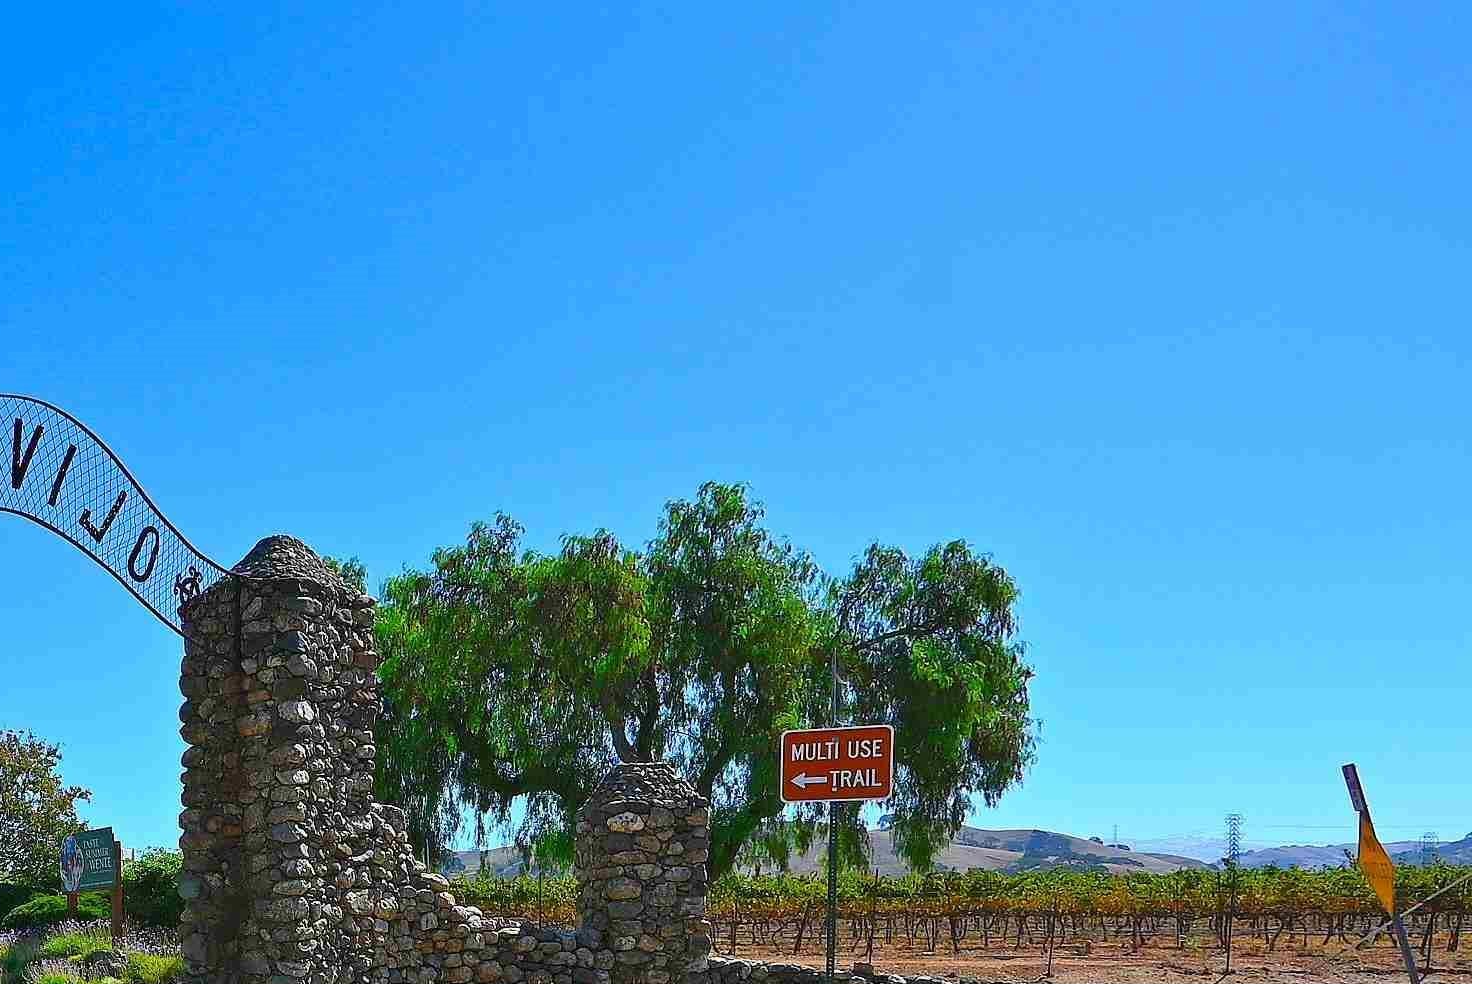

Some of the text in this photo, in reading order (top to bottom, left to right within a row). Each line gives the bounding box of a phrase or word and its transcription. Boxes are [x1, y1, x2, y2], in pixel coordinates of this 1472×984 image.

[791, 740, 883, 761] MULTI USE
[829, 769, 882, 787] TRAIL
